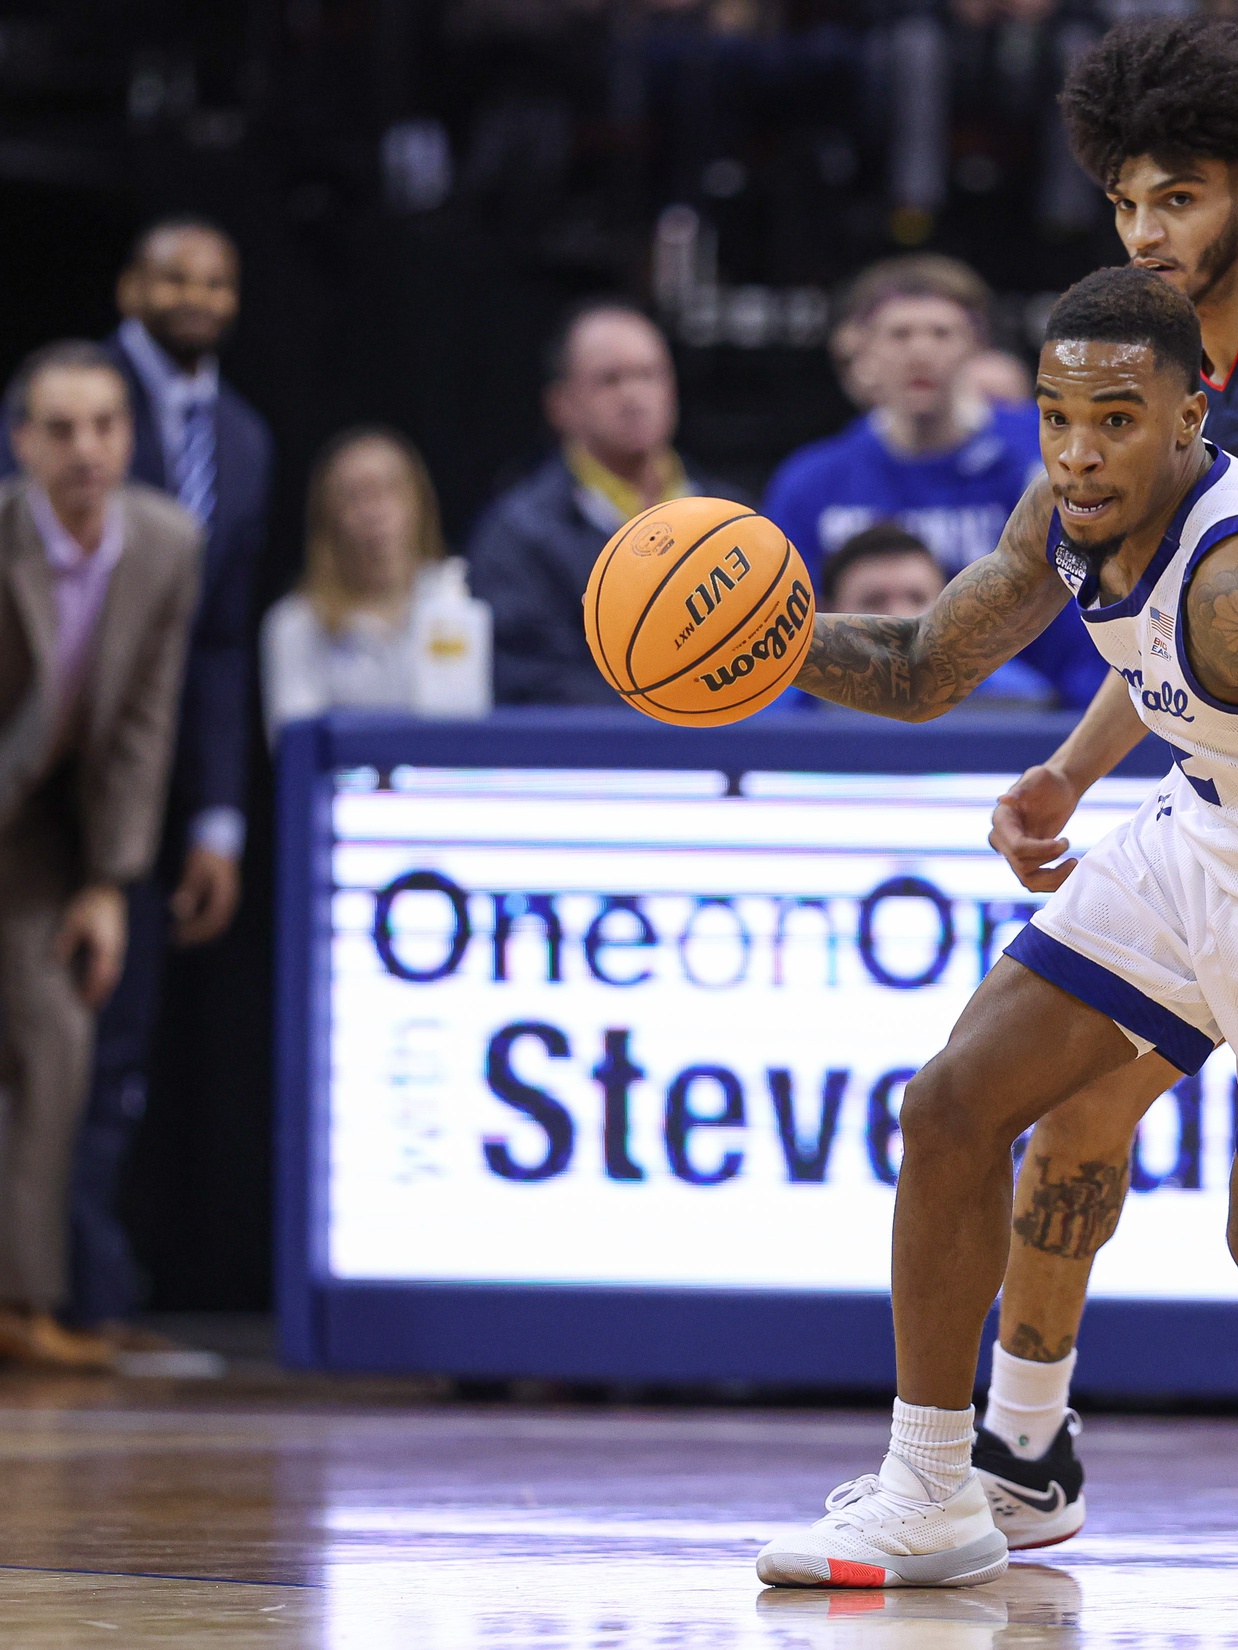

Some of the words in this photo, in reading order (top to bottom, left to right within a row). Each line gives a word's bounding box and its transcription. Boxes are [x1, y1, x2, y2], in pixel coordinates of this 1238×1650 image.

[674, 622, 695, 651] NXT
[700, 579, 811, 692] Wilson
[1153, 637, 1168, 651] BIG
[1151, 644, 1173, 661] EAST
